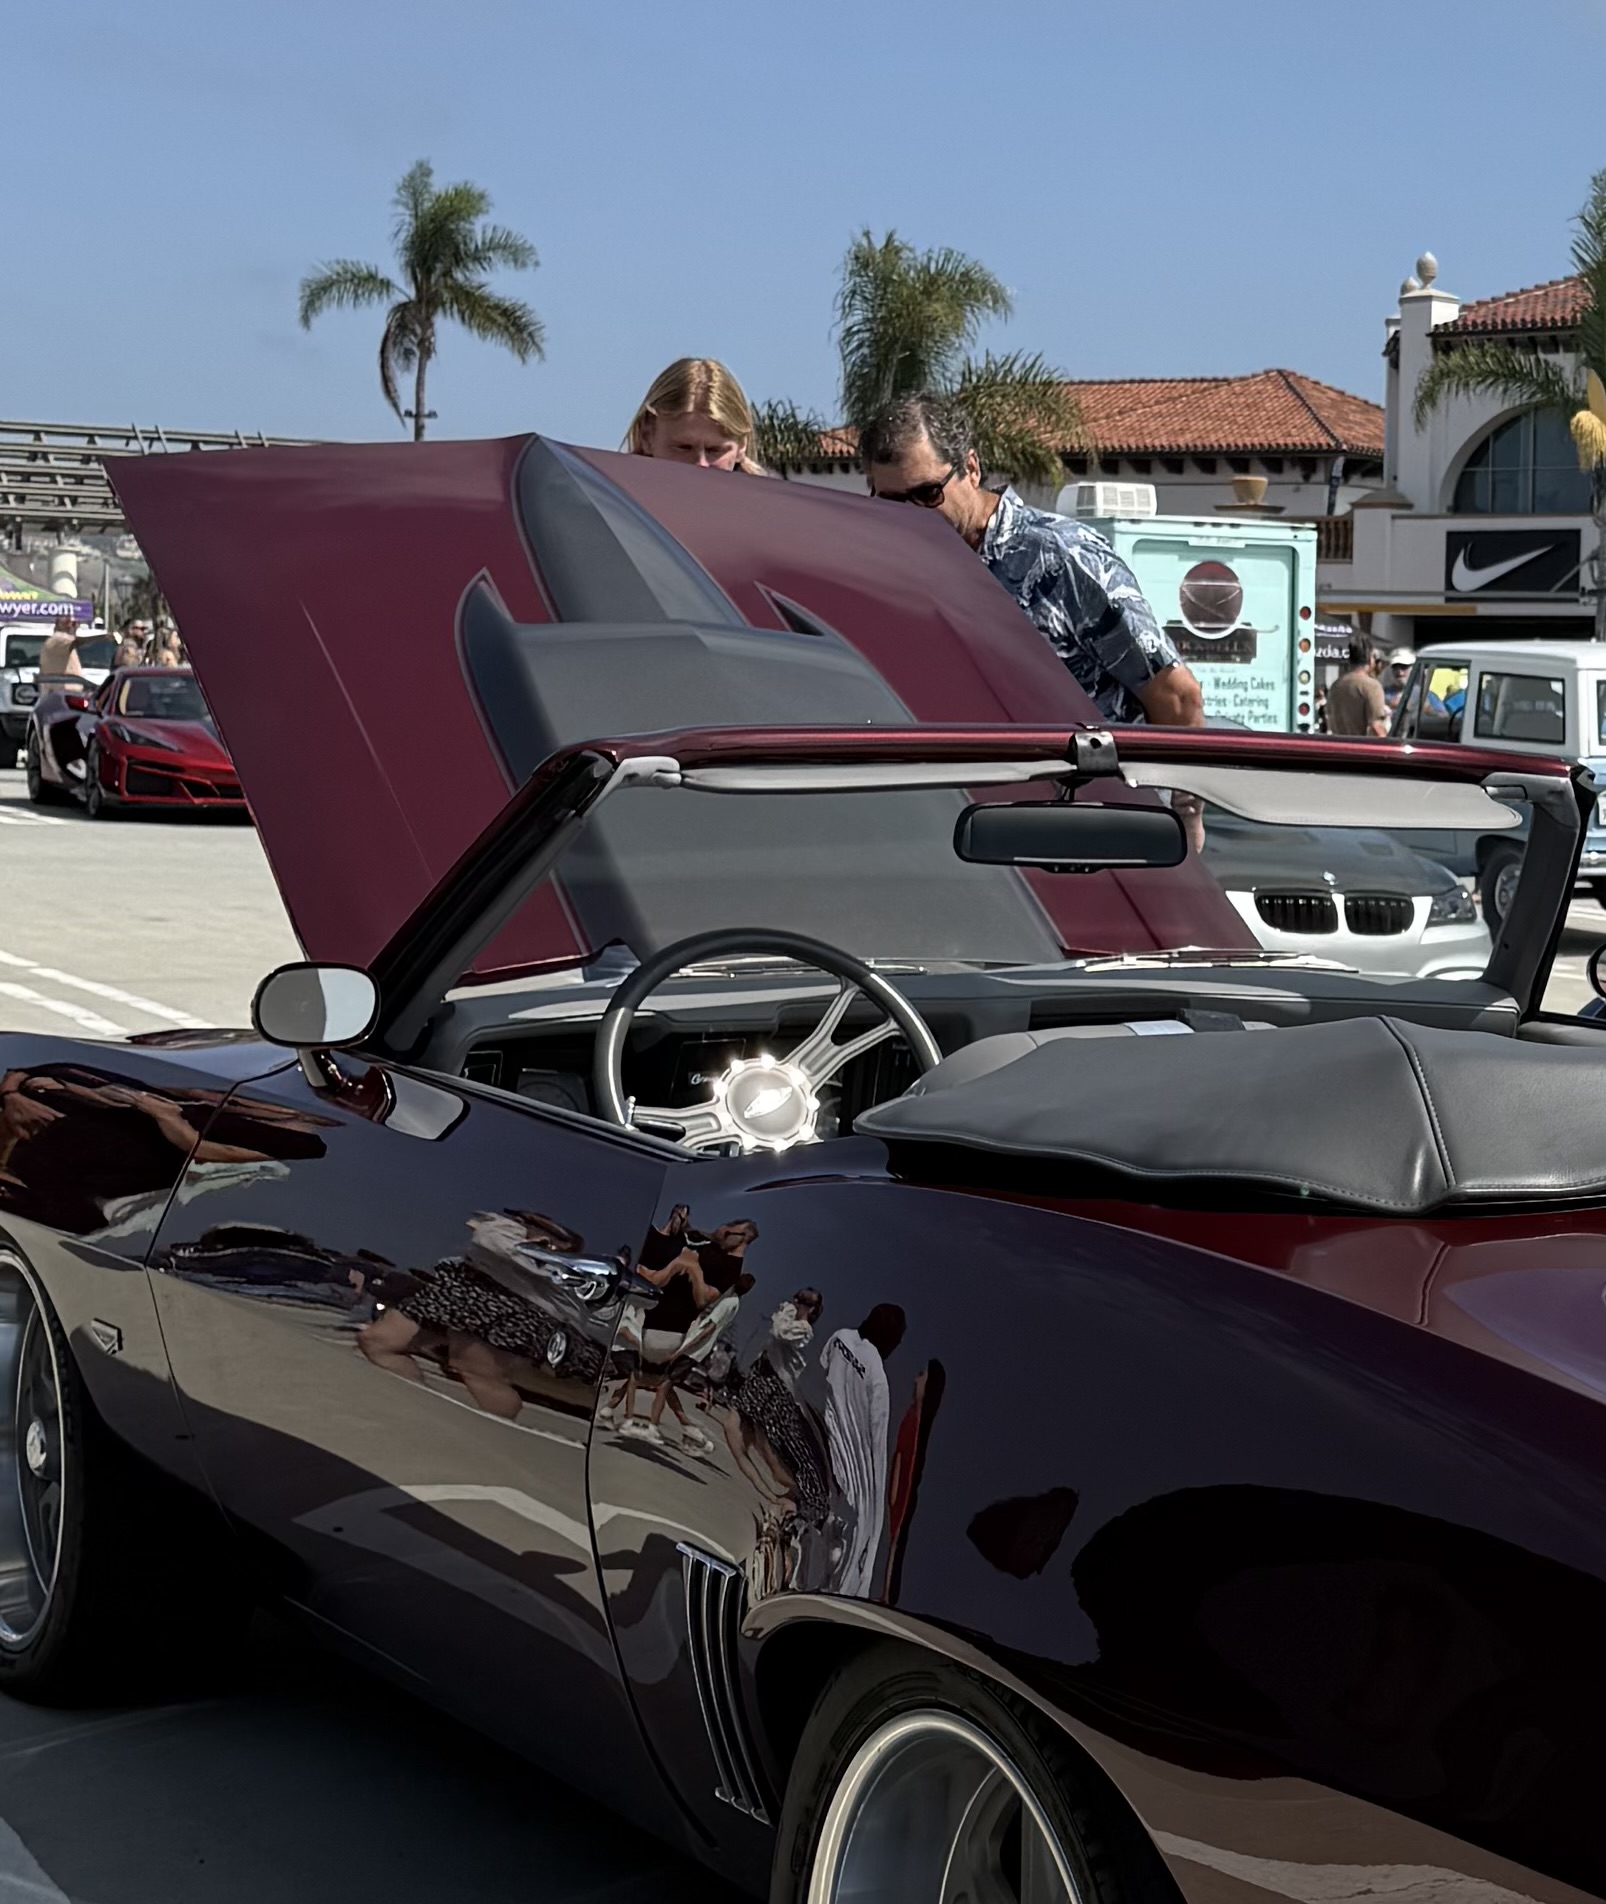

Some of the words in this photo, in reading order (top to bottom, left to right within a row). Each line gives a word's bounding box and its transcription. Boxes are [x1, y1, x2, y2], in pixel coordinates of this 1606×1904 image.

[1213, 676, 1249, 693] Wedding
[1250, 676, 1276, 691] Cakes
[1233, 693, 1270, 710] Catering
